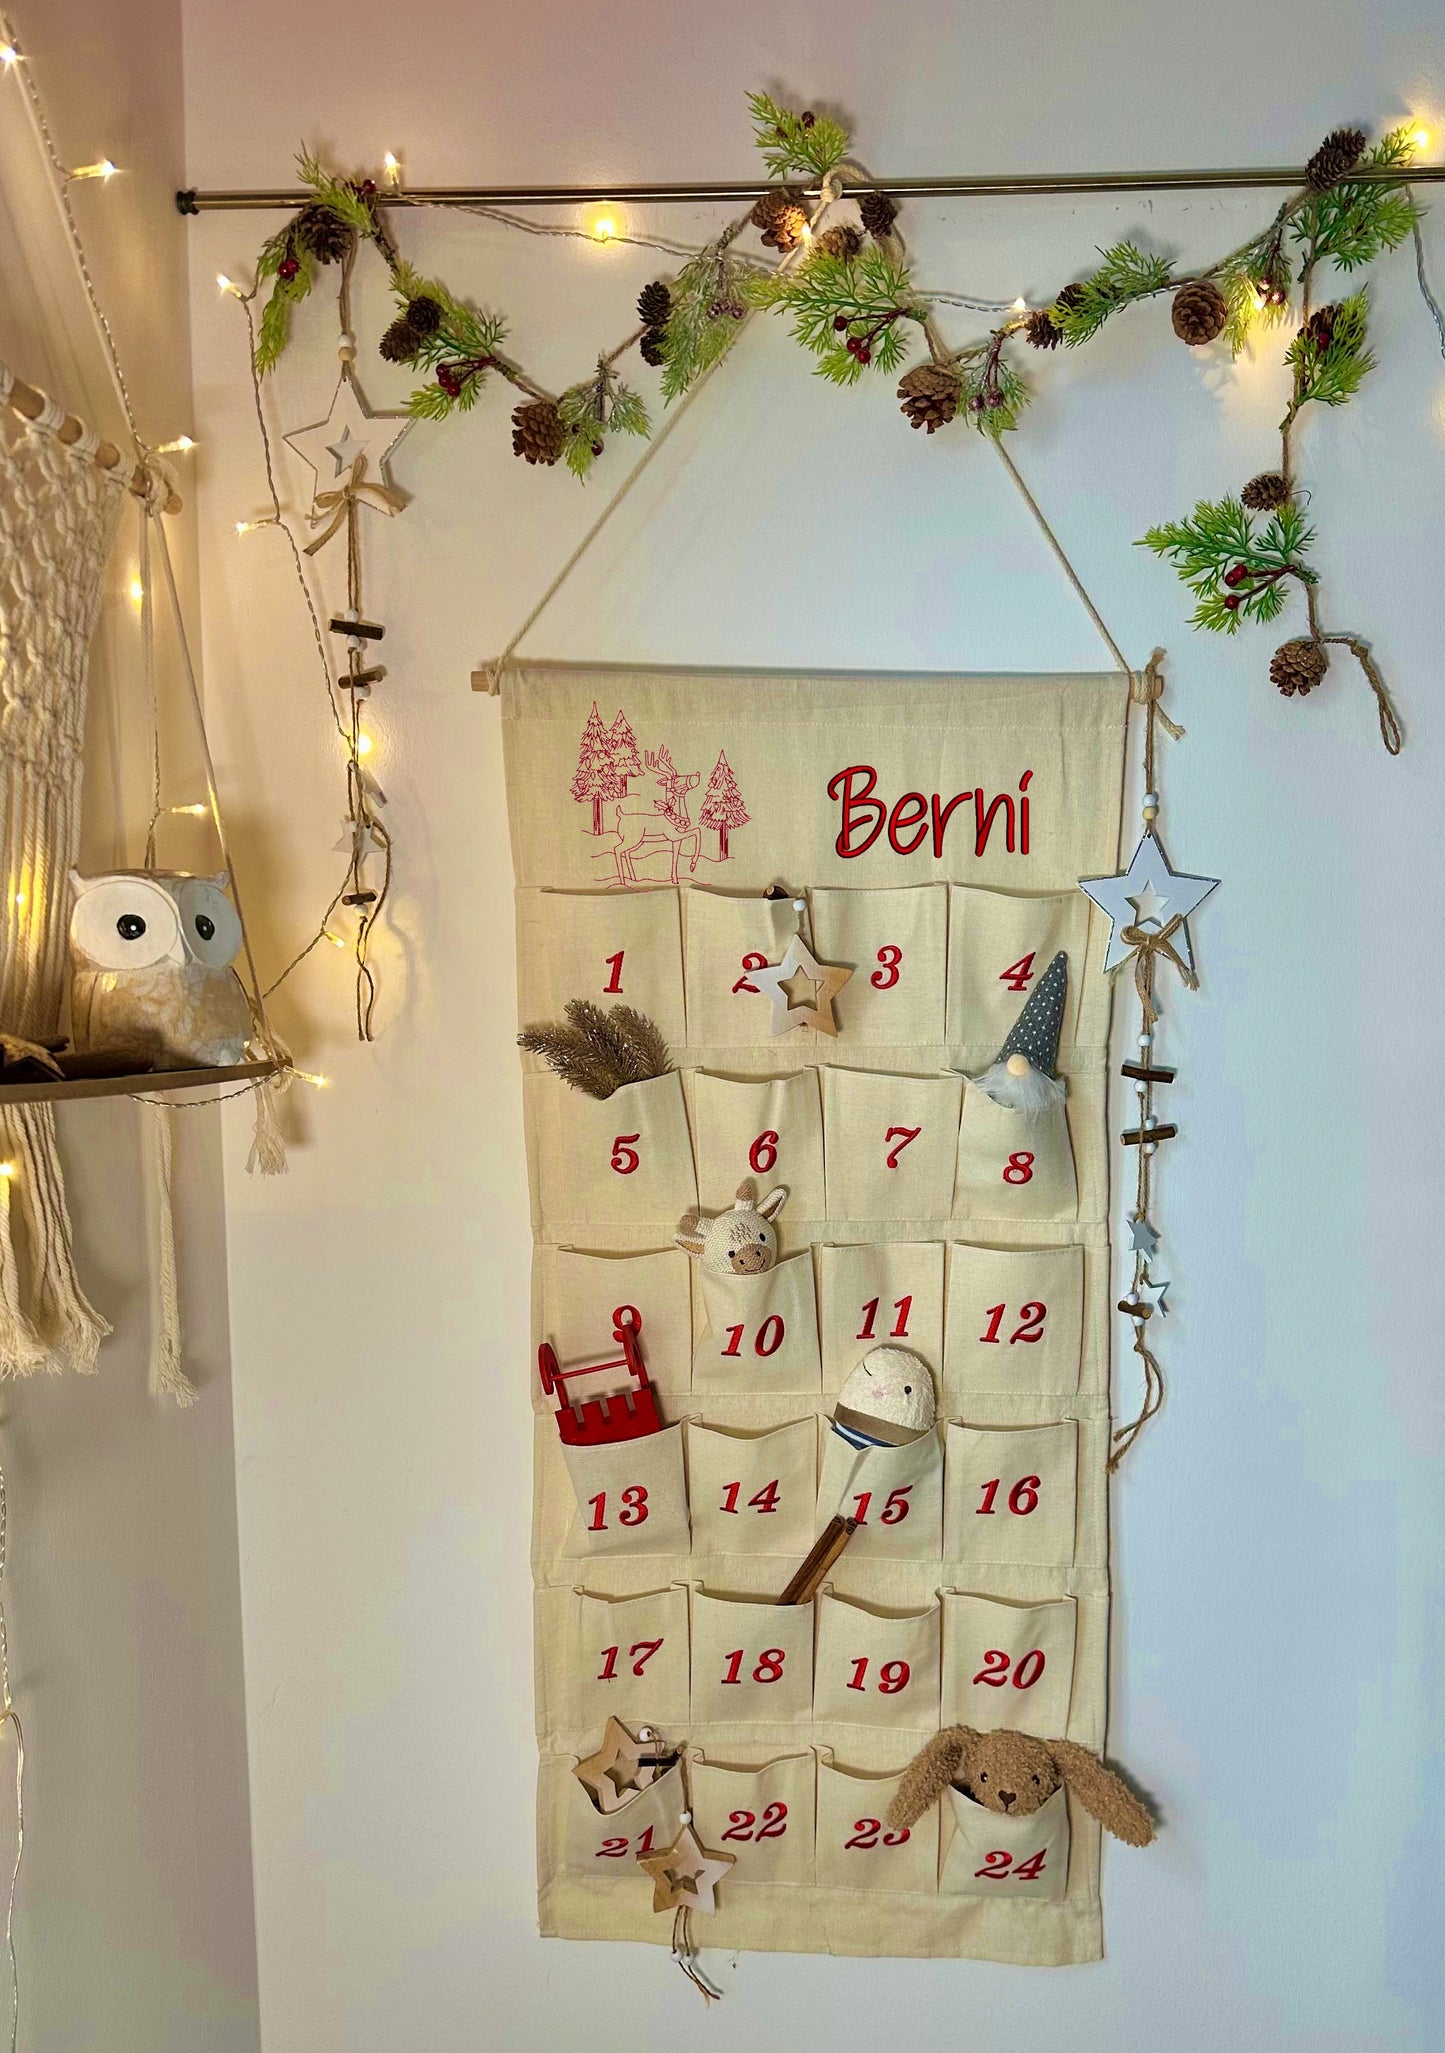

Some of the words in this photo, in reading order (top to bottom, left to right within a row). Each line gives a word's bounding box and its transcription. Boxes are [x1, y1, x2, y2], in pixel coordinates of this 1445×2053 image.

[602, 950, 625, 994] 1
[870, 944, 903, 990] 3
[1000, 952, 1036, 992] 4
[610, 1133, 641, 1175] 5
[748, 1130, 779, 1174] 6
[884, 1126, 922, 1169] 7
[1002, 1151, 1035, 1185] 8
[612, 1304, 642, 1344] 9
[720, 1314, 785, 1357] 10
[856, 1295, 913, 1340] 11
[979, 1301, 1047, 1345] 12
[587, 1485, 649, 1531] 13
[720, 1479, 781, 1515] 14
[850, 1484, 914, 1525] 15
[975, 1475, 1041, 1516] 16
[598, 1638, 664, 1680] 17
[721, 1648, 786, 1685] 18
[846, 1657, 911, 1694] 19
[972, 1649, 1046, 1690] 20
[595, 1825, 655, 1858] 21
[721, 1801, 788, 1842] 22
[974, 1849, 1047, 1881] 24
